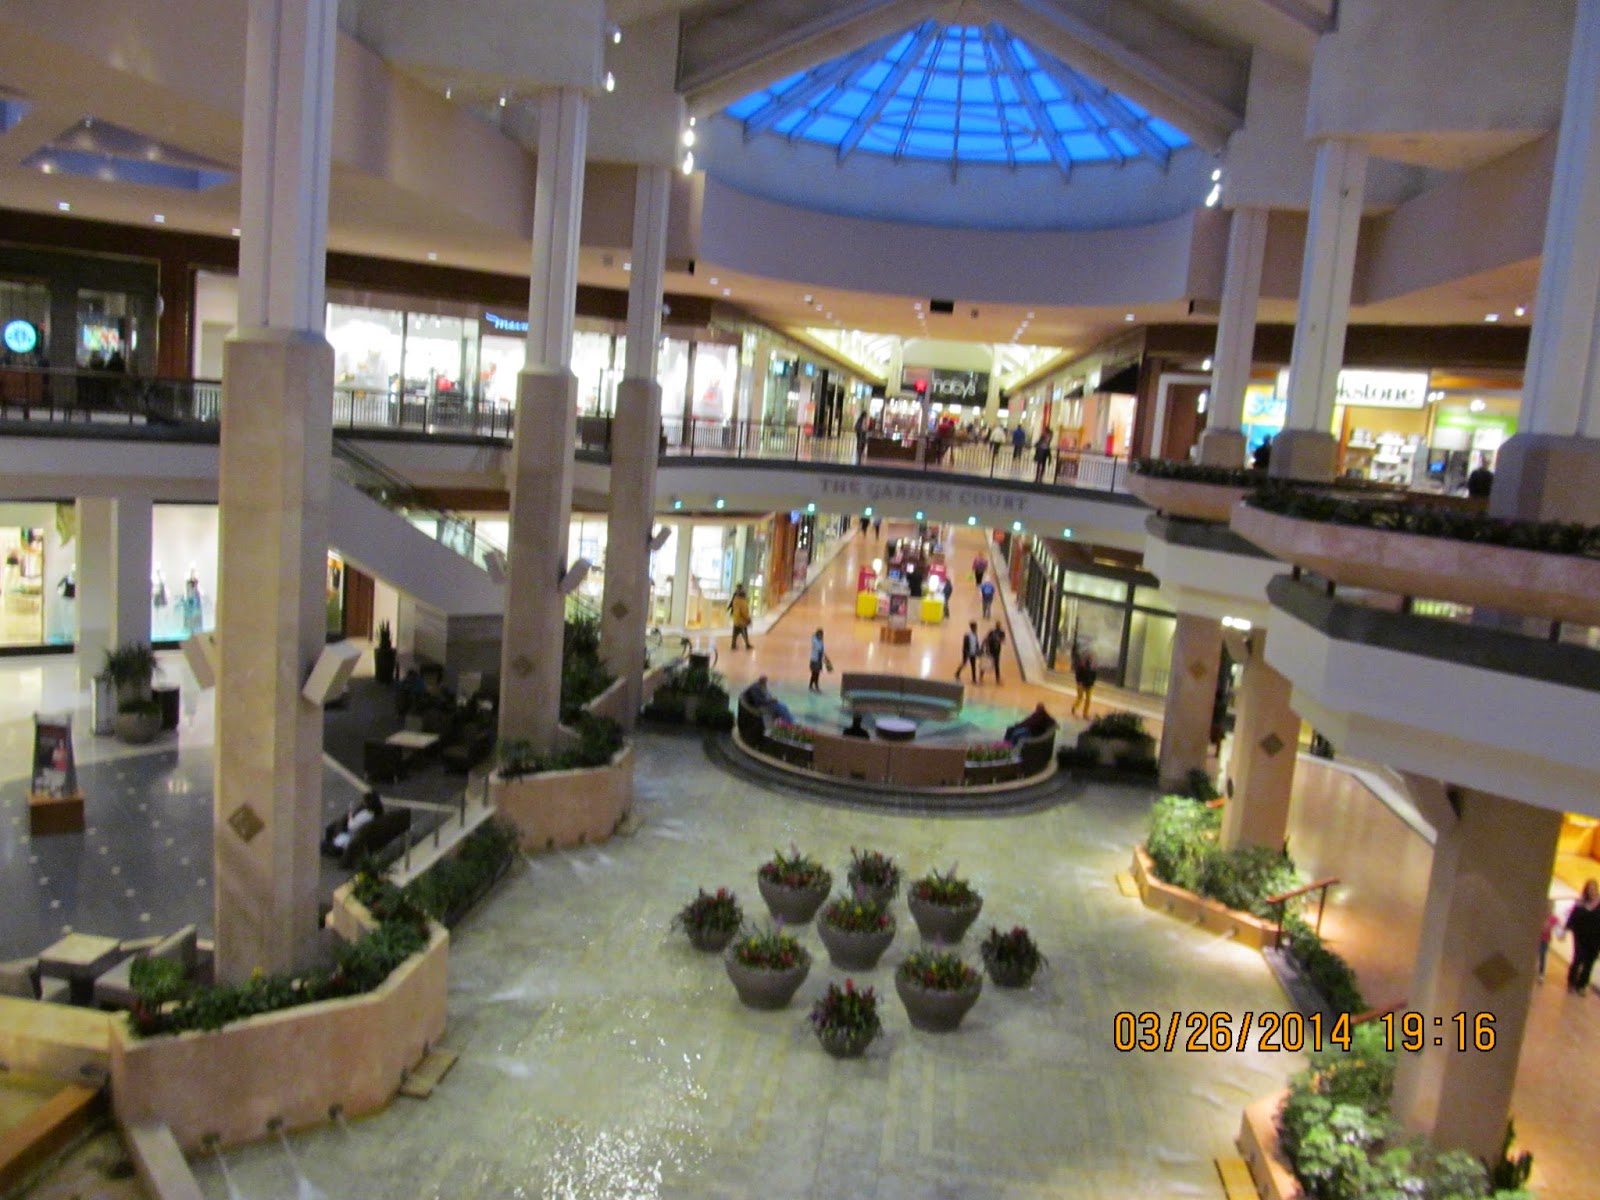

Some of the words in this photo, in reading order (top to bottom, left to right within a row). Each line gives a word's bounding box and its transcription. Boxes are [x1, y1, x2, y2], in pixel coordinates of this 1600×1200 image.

[821, 477, 862, 497] THE
[866, 480, 951, 503] GARDEN
[958, 487, 1027, 511] COURT
